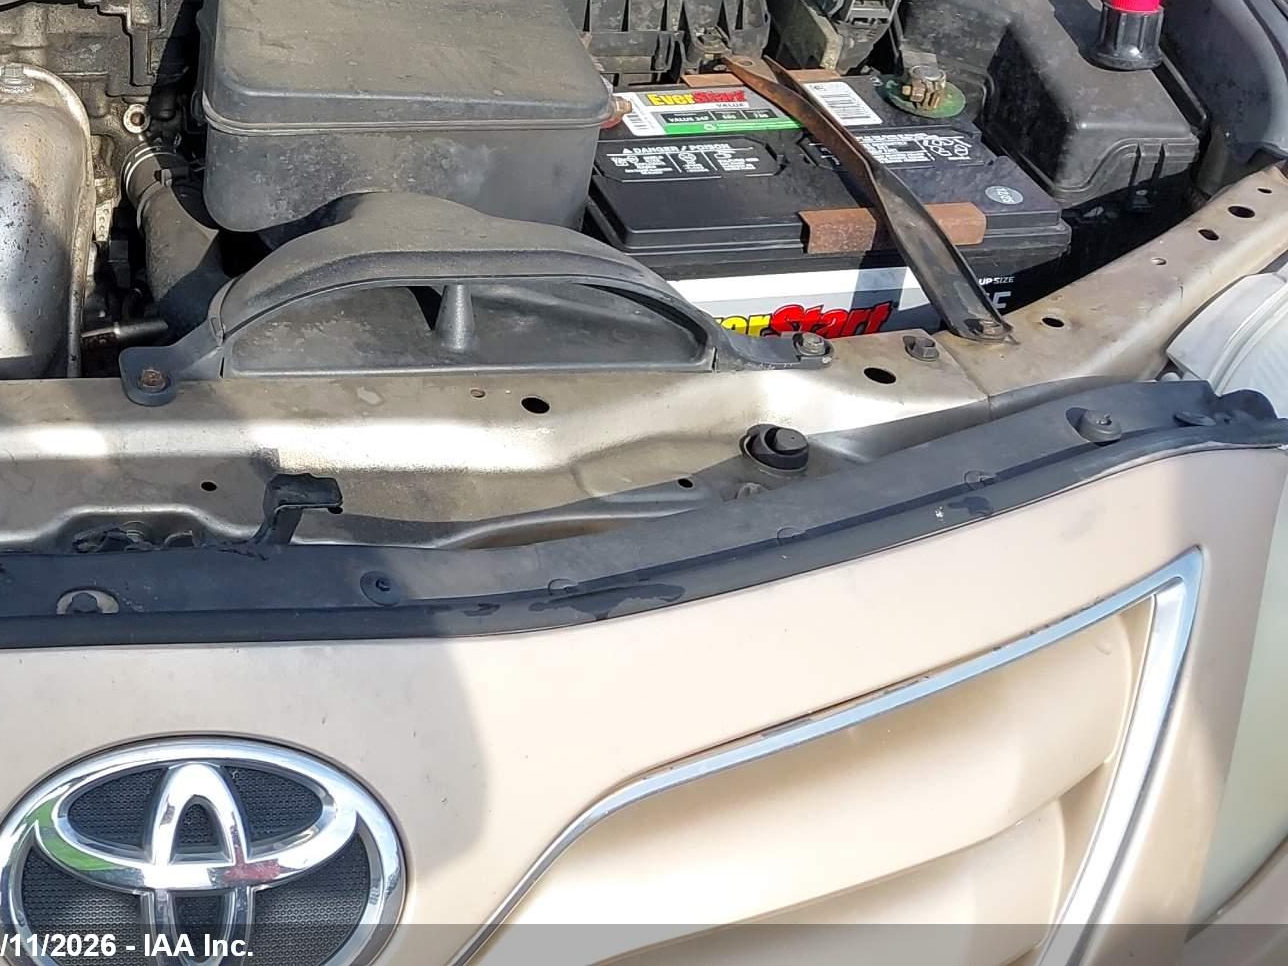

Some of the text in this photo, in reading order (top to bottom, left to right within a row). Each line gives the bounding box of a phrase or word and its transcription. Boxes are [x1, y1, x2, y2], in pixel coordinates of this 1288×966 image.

[647, 90, 745, 106] EverStart
[632, 145, 680, 154] DANGER
[689, 143, 731, 151] POISON
[993, 276, 1015, 285] SIZE
